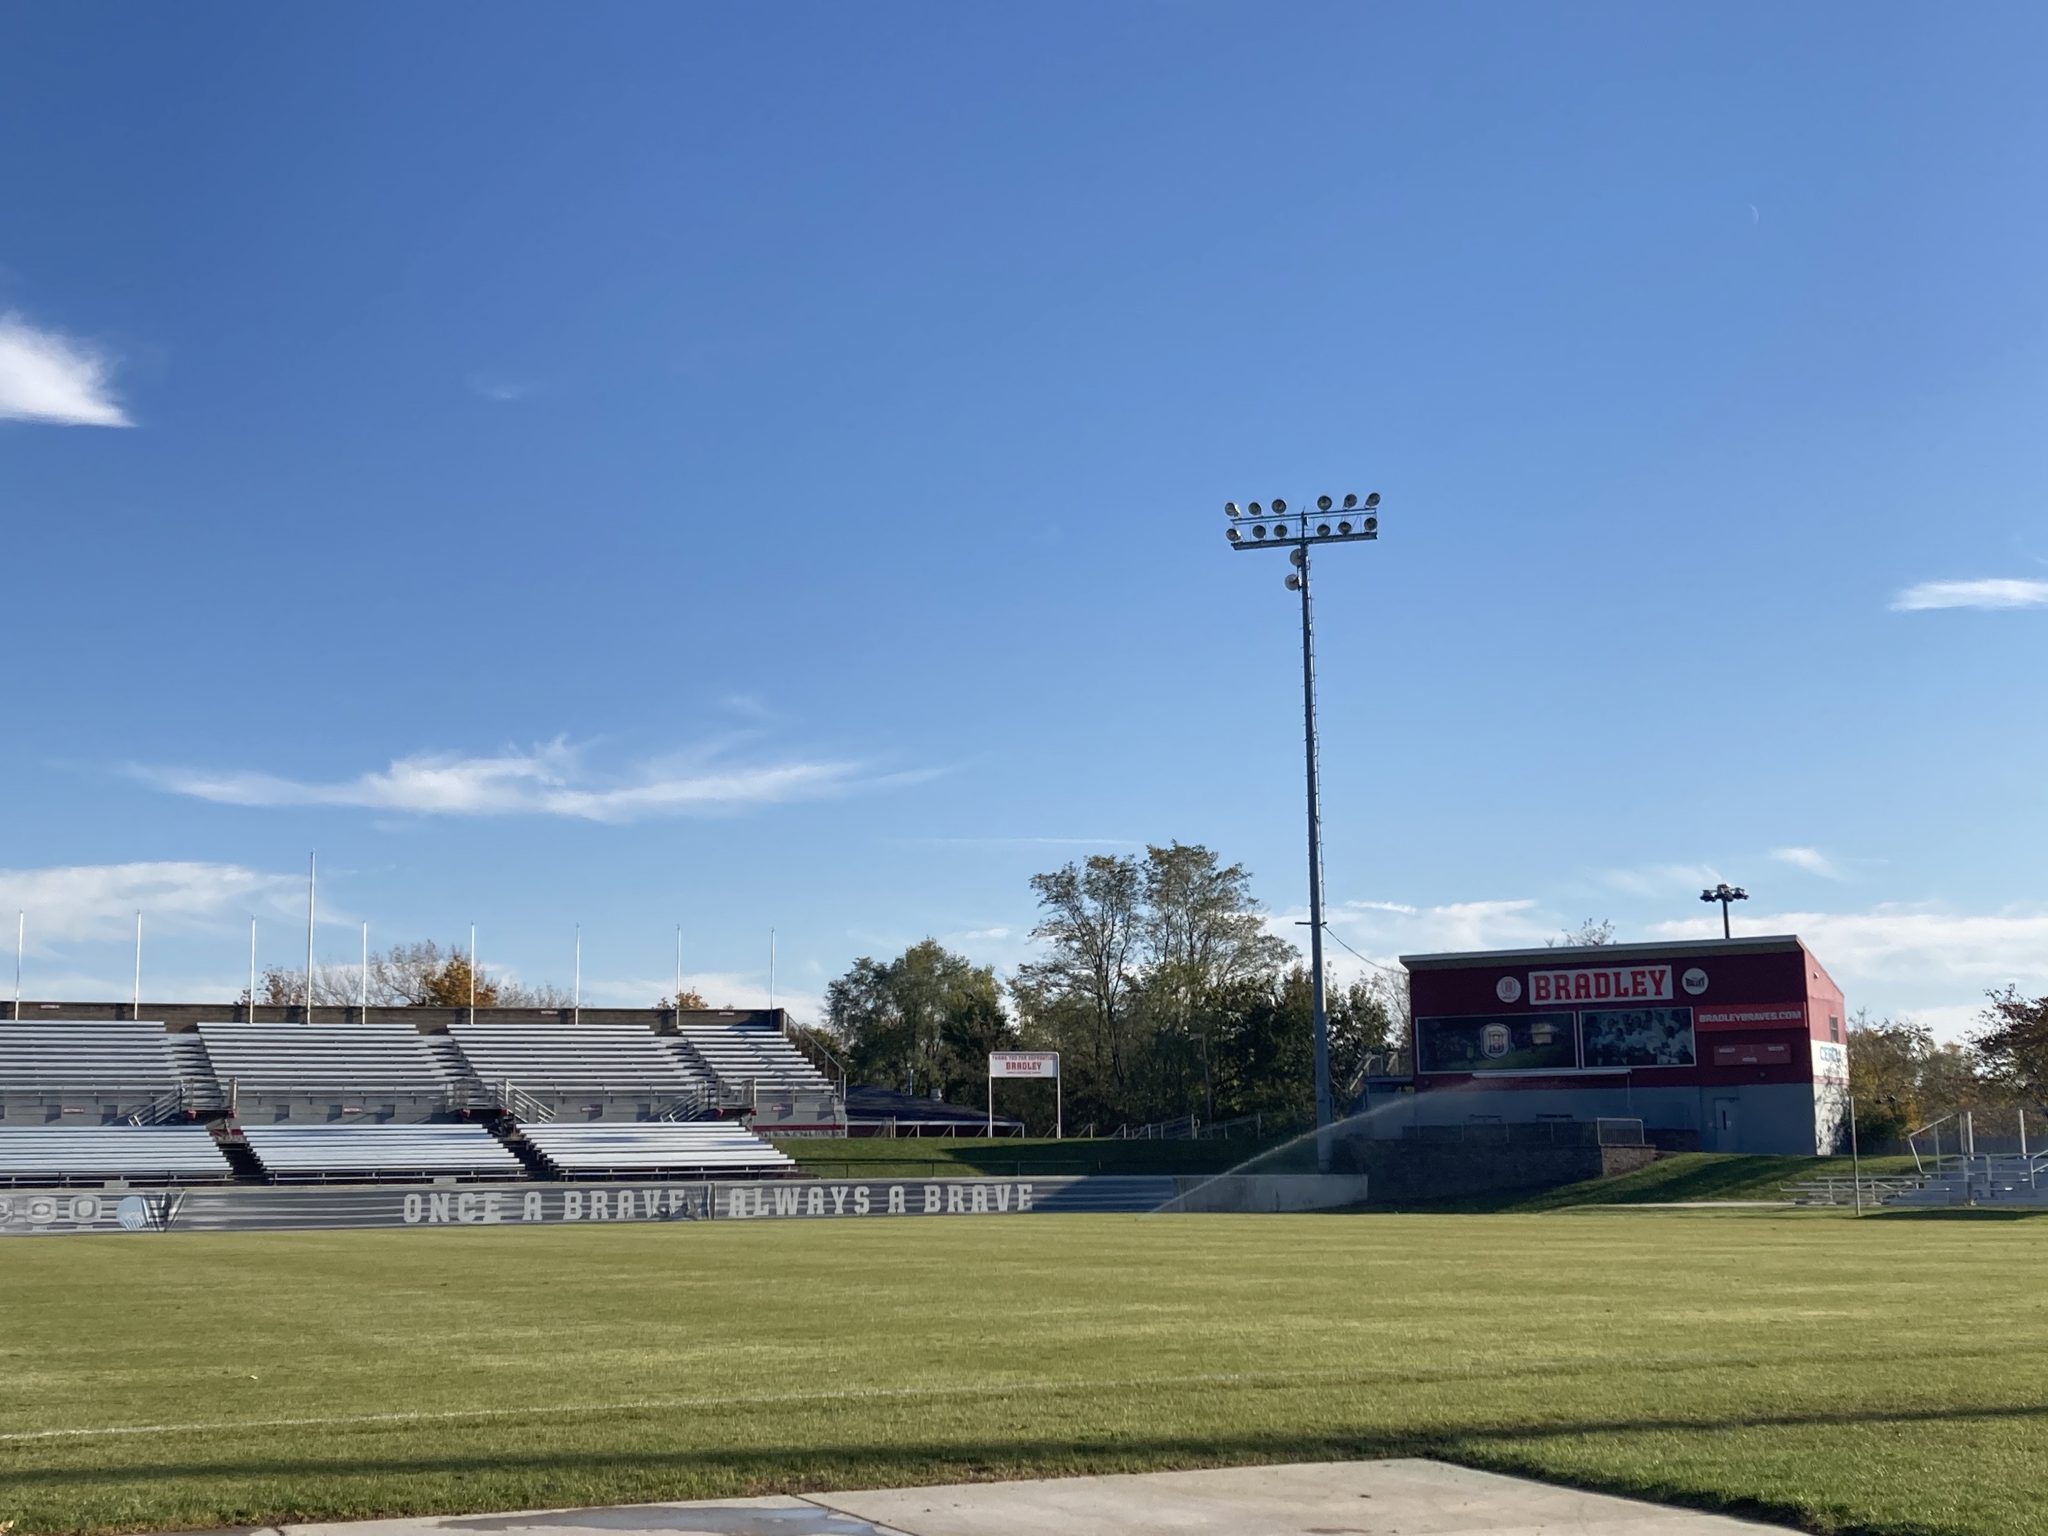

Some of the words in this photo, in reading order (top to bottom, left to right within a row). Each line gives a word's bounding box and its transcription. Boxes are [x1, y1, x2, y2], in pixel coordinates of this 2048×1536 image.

[1534, 970, 1667, 1001] BRADLEY
[1699, 1011, 1802, 1023] BRADLEYBRAVES.COM
[1006, 1062, 1041, 1070] BRADLEY
[403, 1192, 502, 1223] ONCE
[522, 1191, 542, 1220] A
[728, 1186, 870, 1217] ALWAYS
[887, 1185, 907, 1213] A
[924, 1183, 1033, 1213] BRAVE
